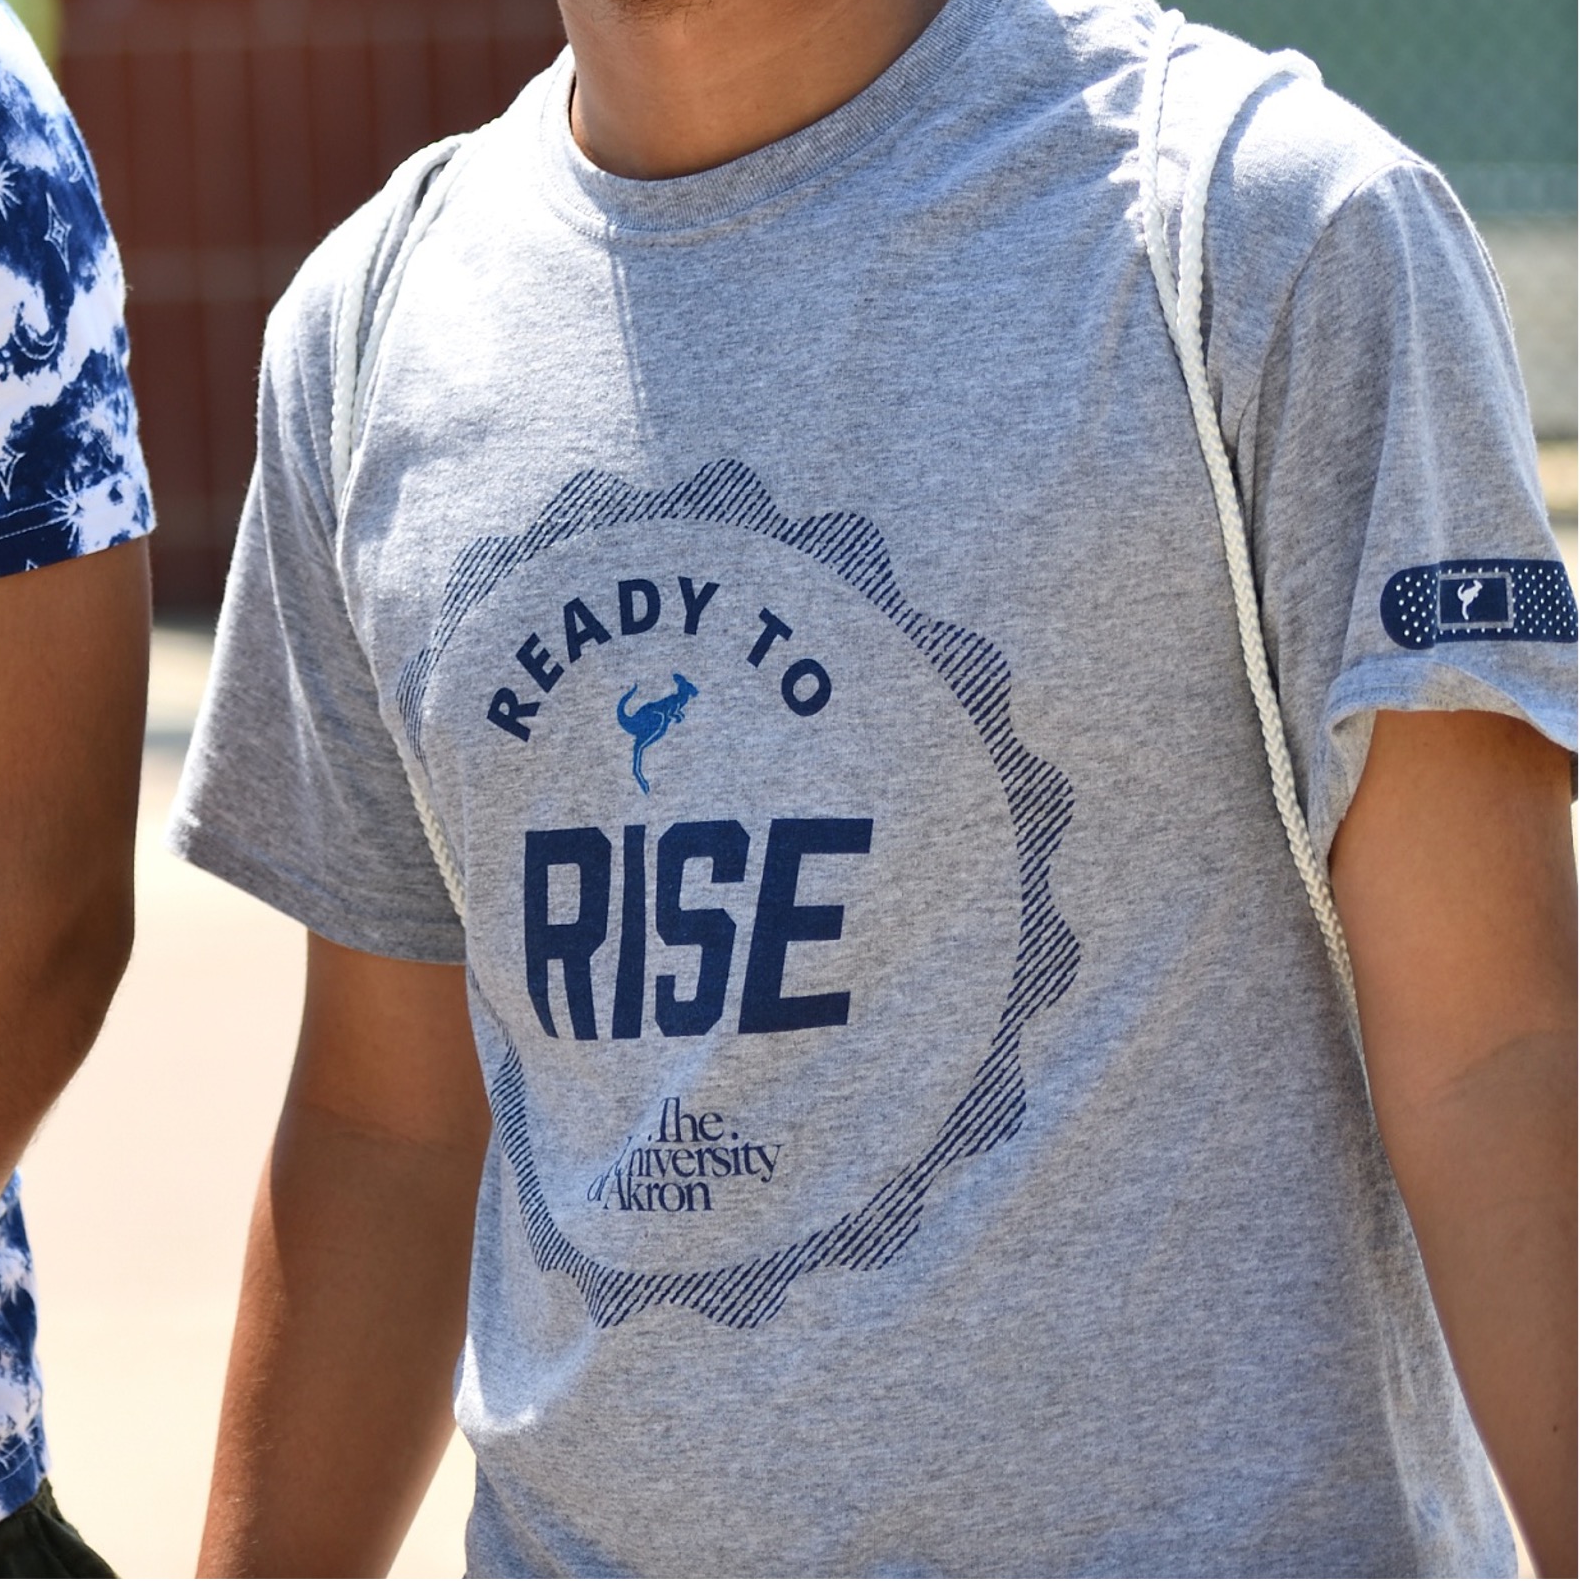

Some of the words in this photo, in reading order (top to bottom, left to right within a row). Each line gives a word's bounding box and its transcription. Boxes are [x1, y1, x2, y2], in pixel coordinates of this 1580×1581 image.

[487, 576, 720, 743] READY
[746, 610, 832, 717] TO
[524, 818, 873, 1040] RISE
[602, 1169, 714, 1213] Akron
